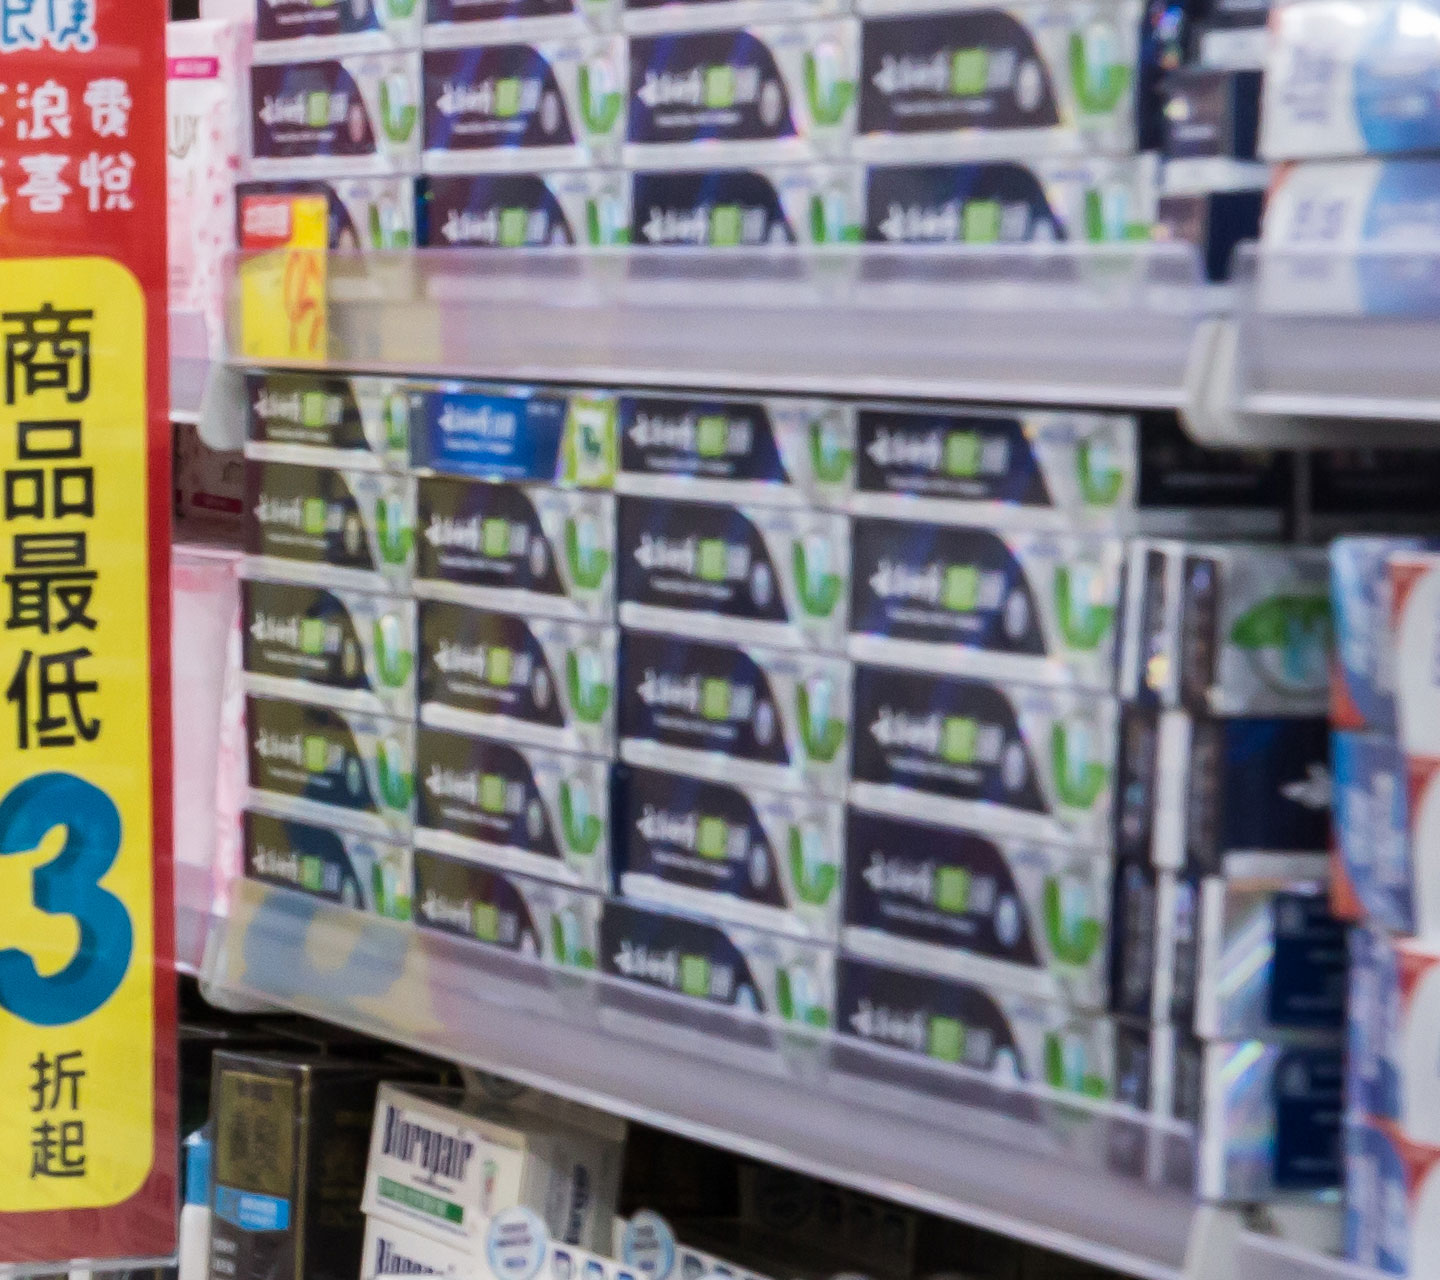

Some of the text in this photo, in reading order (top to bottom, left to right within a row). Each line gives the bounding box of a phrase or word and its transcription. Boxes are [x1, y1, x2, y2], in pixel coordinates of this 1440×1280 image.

[1, 302, 102, 751] 商品最低
[28, 1050, 86, 1179] 折起
